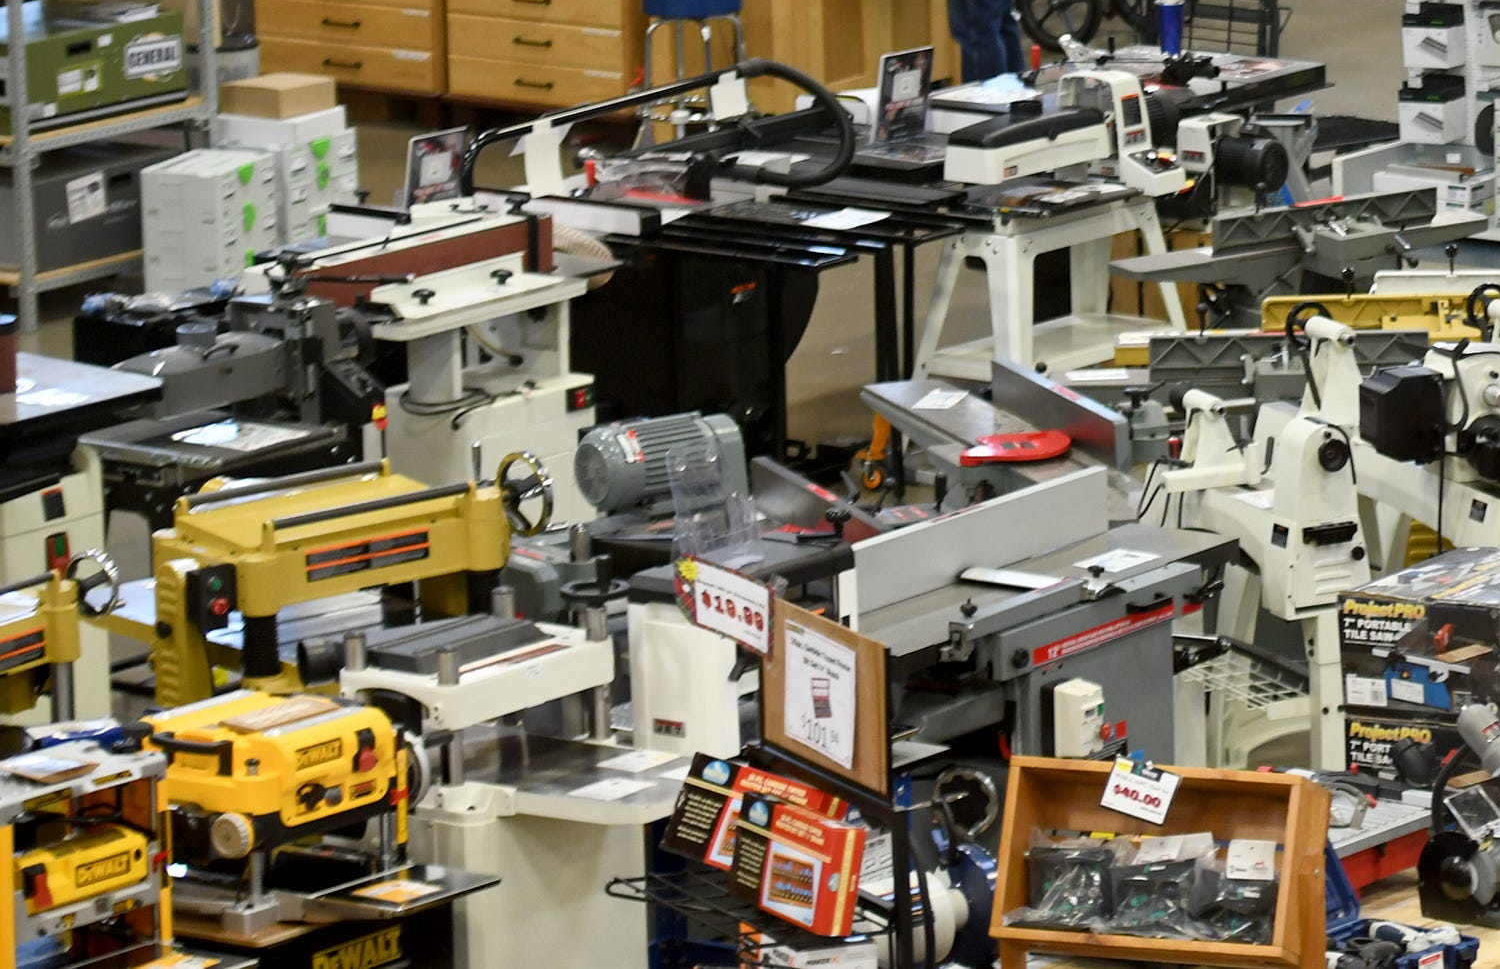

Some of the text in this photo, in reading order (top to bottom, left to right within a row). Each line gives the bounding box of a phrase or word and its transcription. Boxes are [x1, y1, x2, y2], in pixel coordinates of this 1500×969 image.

[1343, 599, 1426, 620] ProjectPRO
[1356, 619, 1412, 632] PORTABLE
[1343, 630, 1394, 642] TILE SAW
[1362, 742, 1392, 752] PORT
[1350, 751, 1393, 766] TILE SA
